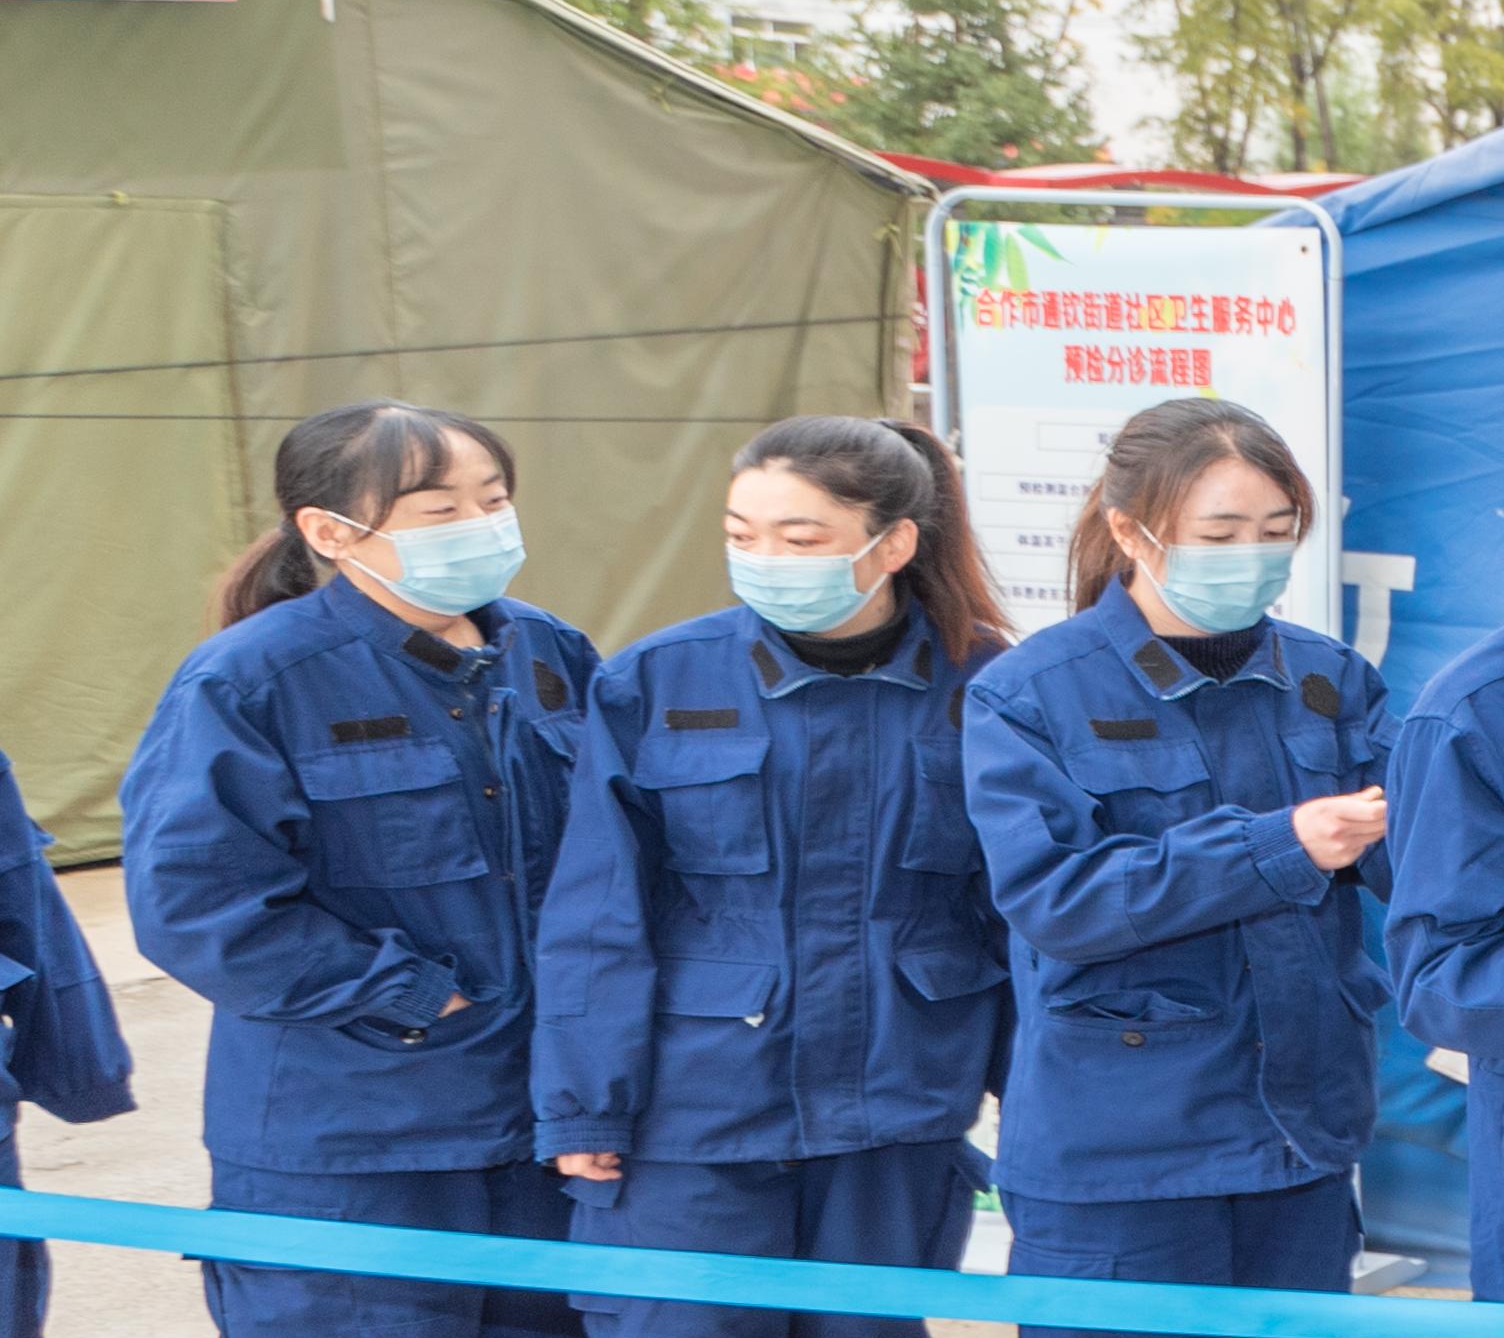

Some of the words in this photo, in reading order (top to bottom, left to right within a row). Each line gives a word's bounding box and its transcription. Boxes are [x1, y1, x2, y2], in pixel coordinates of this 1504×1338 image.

[1064, 346, 1212, 387] 预检分诊流程图
